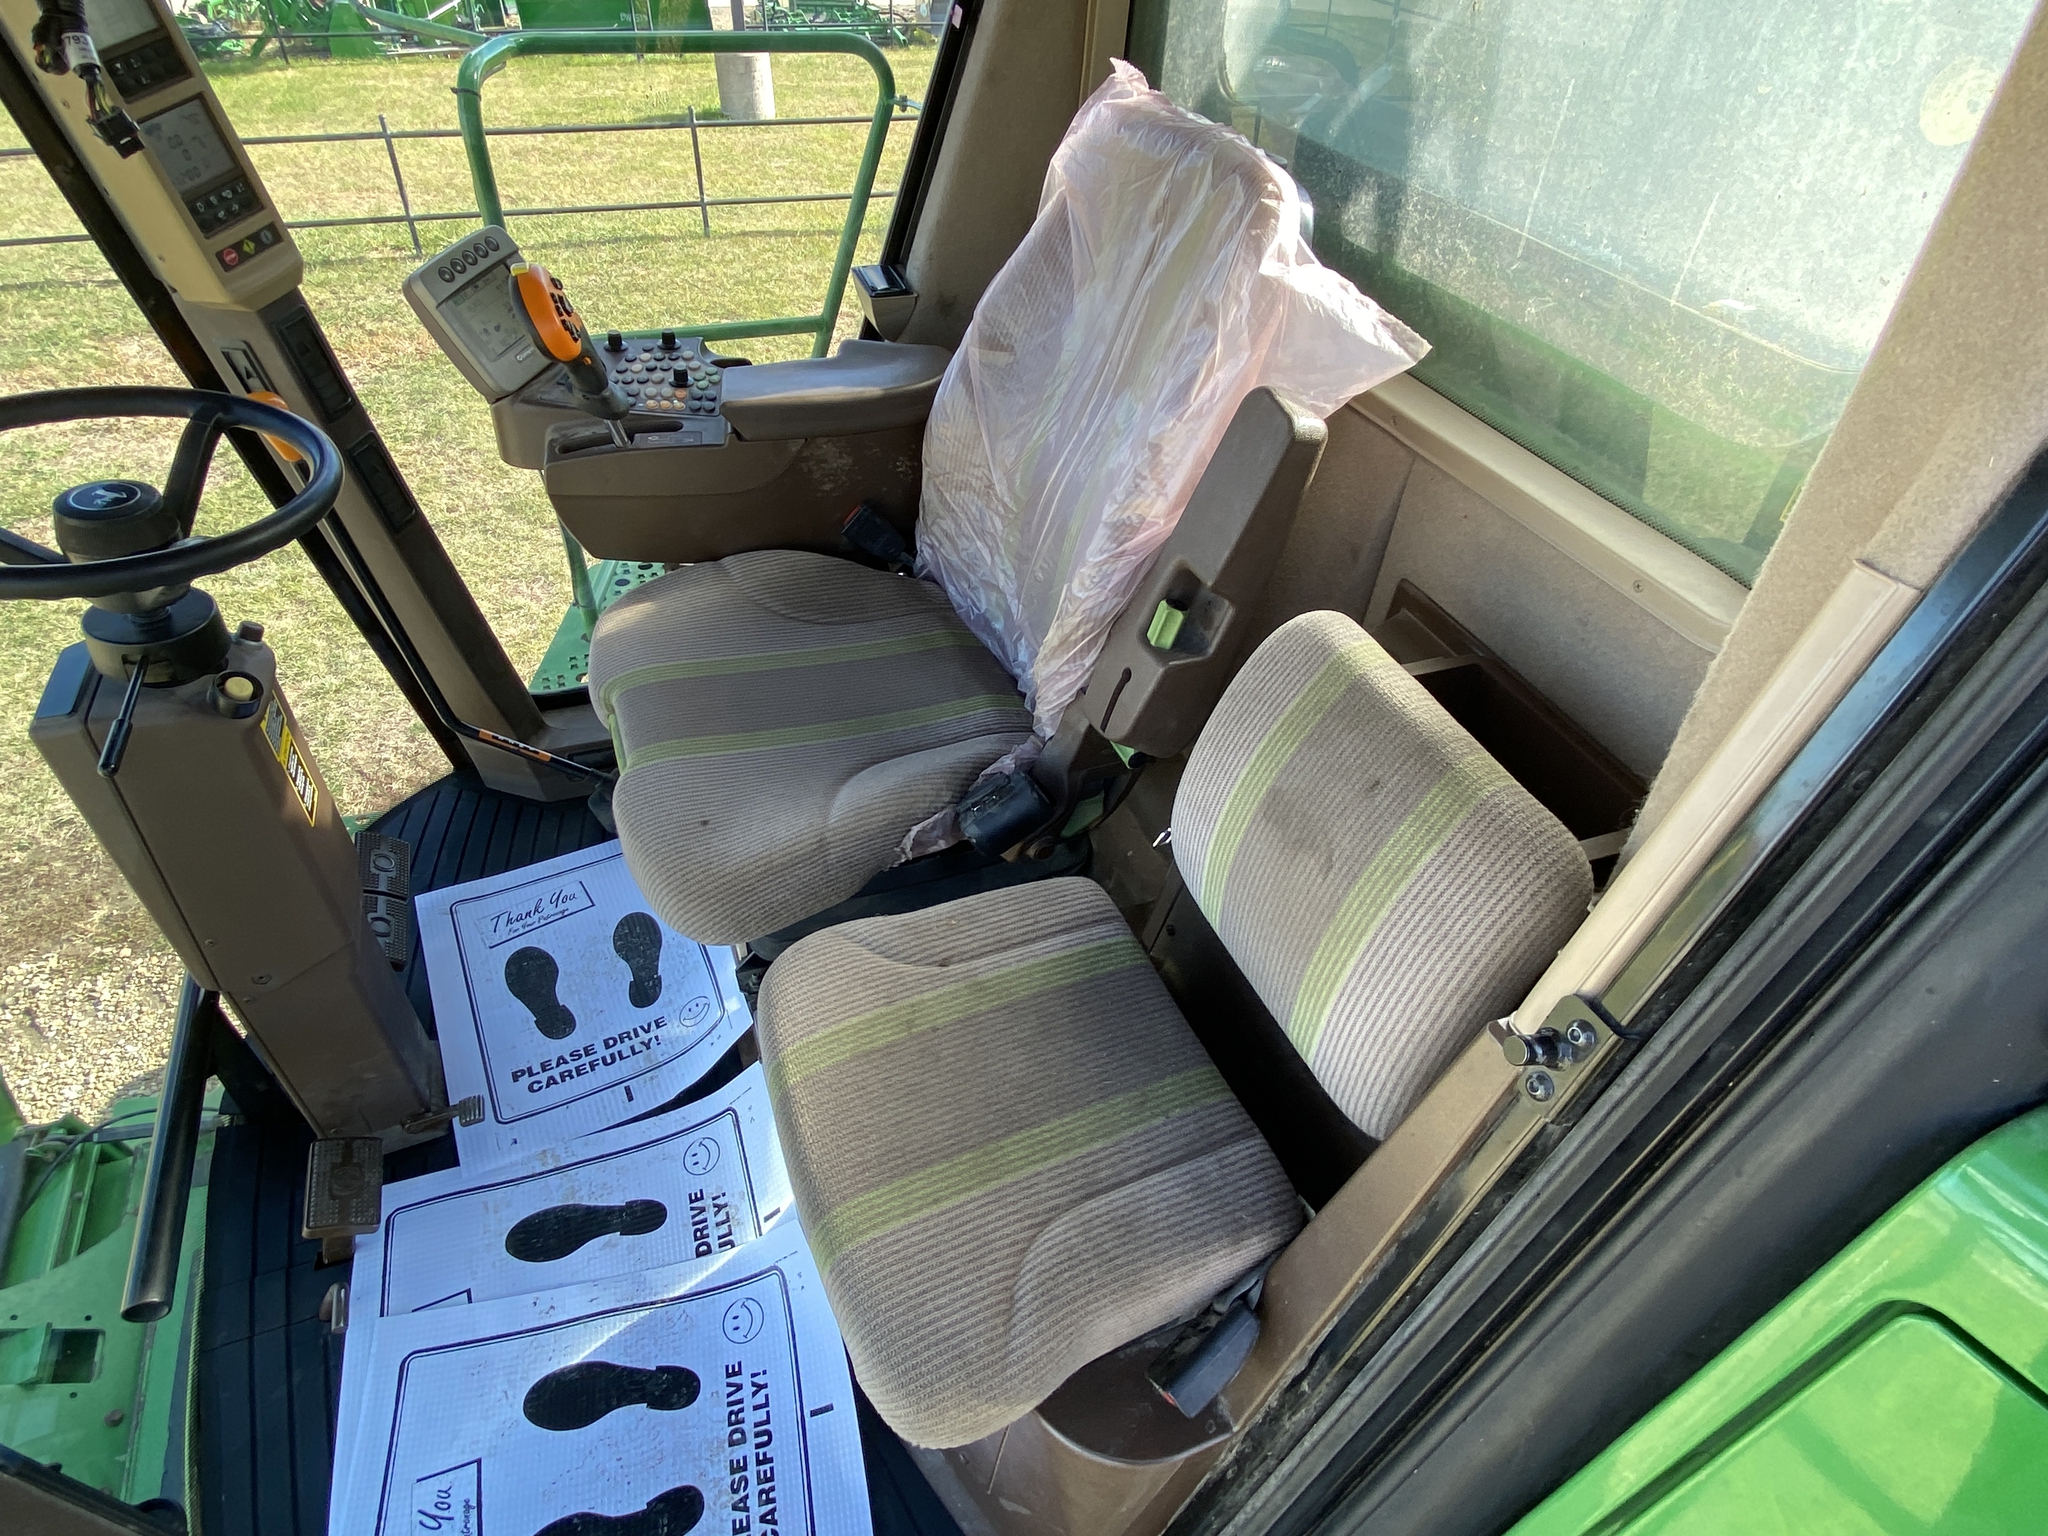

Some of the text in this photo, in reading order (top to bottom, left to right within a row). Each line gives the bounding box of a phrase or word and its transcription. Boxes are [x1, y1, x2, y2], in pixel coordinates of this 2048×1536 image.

[490, 889, 578, 933] Thank You
[511, 1016, 667, 1083] PLEASE DRIVE
[527, 1035, 661, 1093] CAREFULLY!
[688, 1188, 713, 1258] DRIVE
[711, 1192, 736, 1250] ULLY!
[725, 1360, 751, 1536] EASE DRIVE
[417, 1485, 455, 1531] You
[461, 1498, 476, 1536] tronage
